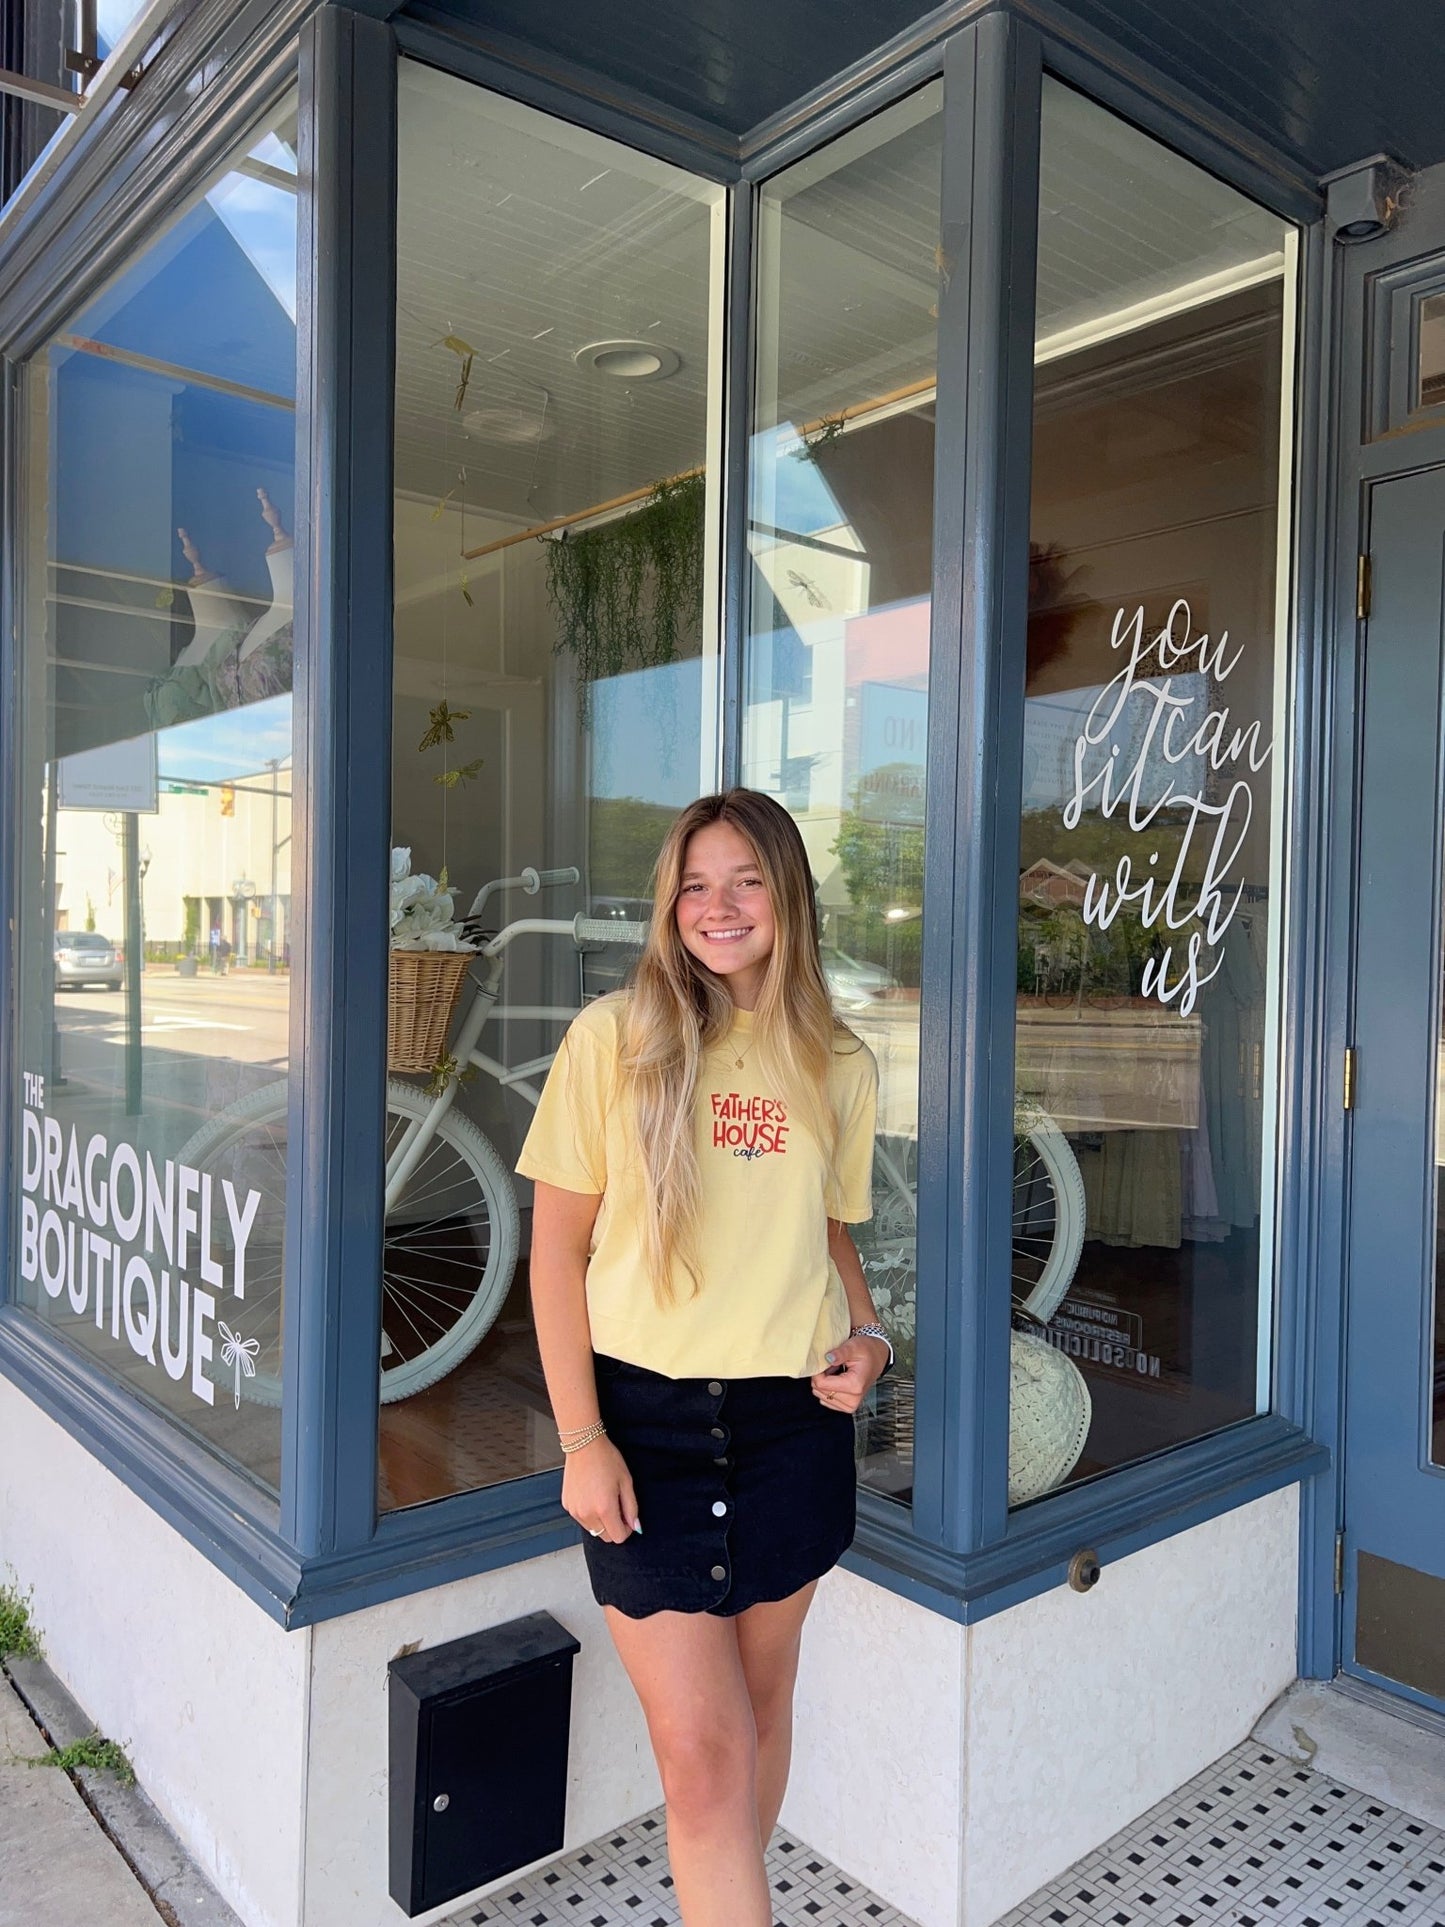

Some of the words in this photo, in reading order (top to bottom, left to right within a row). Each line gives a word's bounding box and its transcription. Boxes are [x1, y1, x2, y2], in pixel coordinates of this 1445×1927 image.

[1085, 598, 1245, 745] you
[1162, 706, 1276, 773] can
[1063, 677, 1195, 832] sit
[1083, 780, 1253, 946] with
[1141, 931, 1226, 1018] us
[23, 1071, 44, 1109] THE
[713, 1120, 790, 1154] HOUSE
[22, 1108, 262, 1300] DRAGONFLY
[21, 1195, 216, 1407] BOUTIQUE
